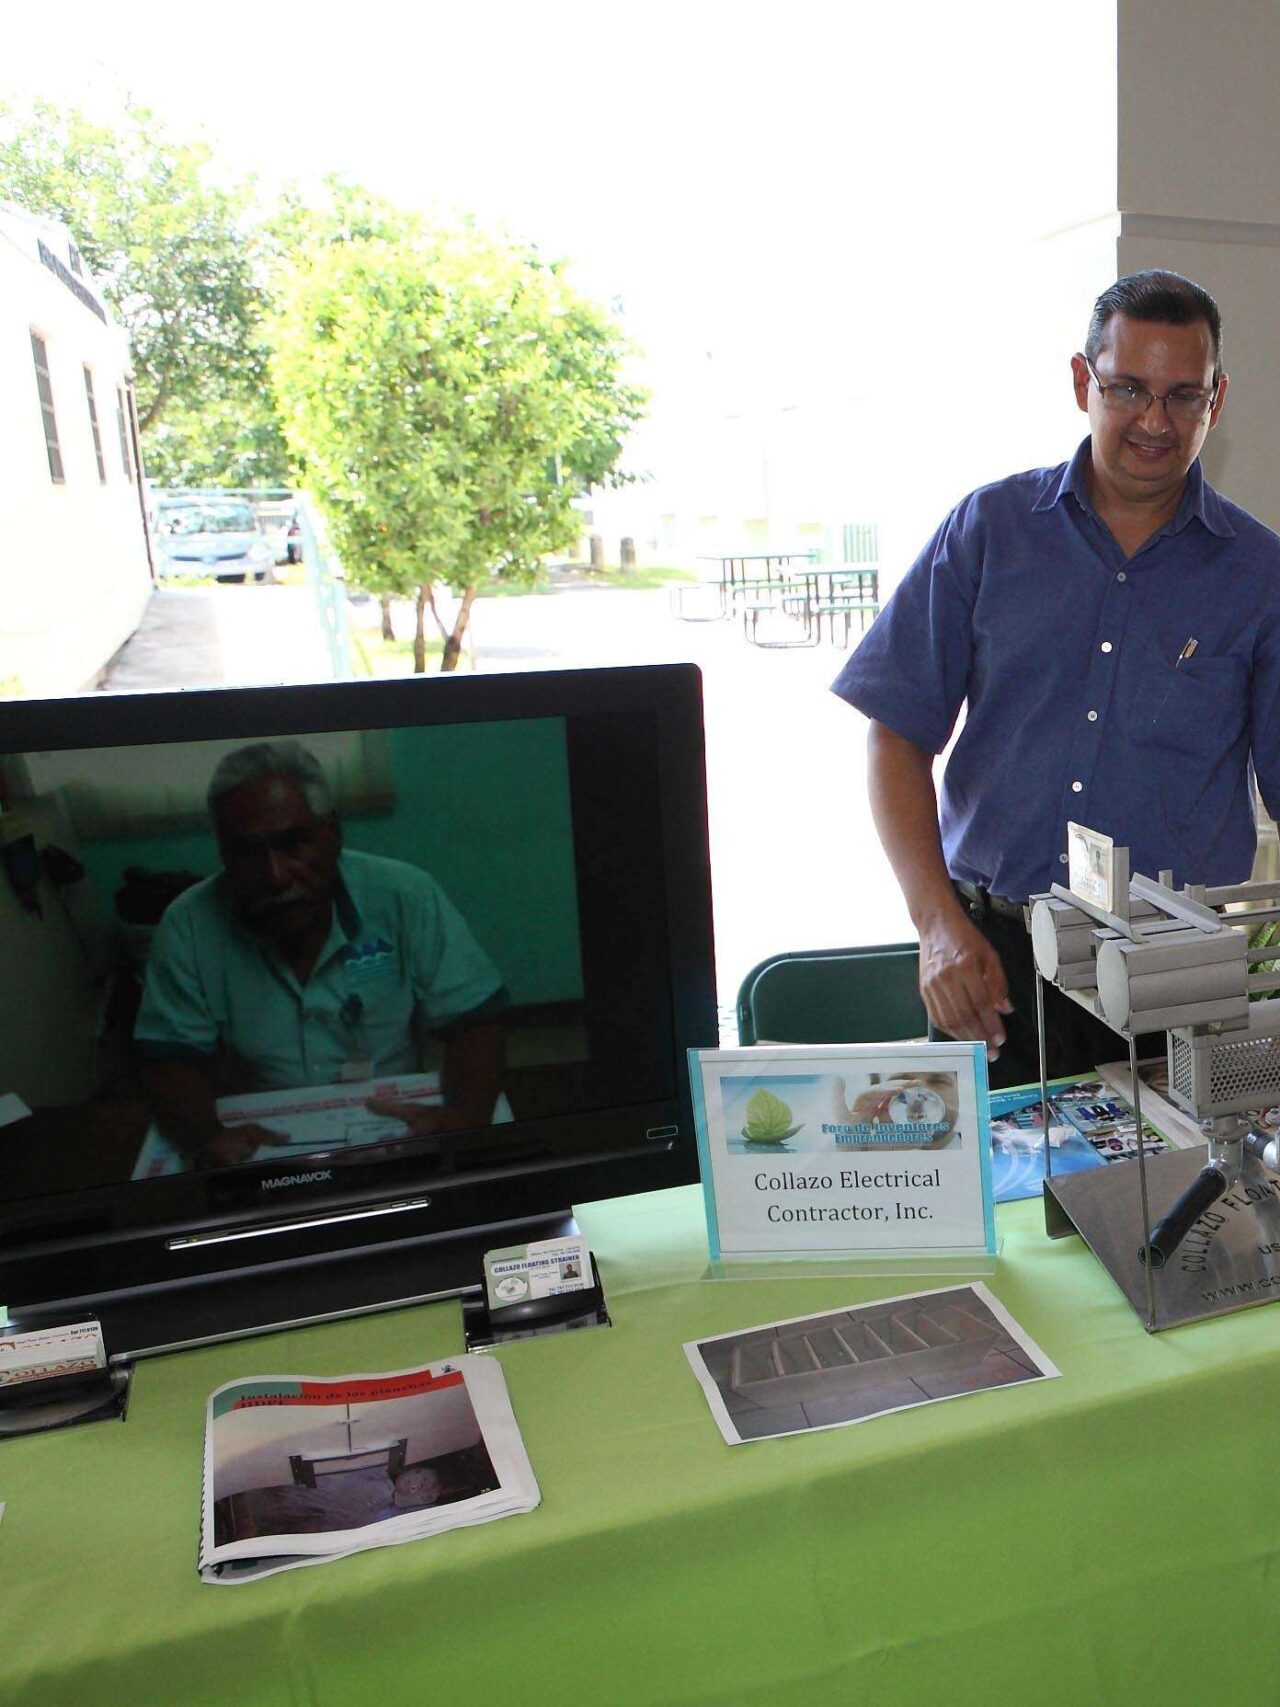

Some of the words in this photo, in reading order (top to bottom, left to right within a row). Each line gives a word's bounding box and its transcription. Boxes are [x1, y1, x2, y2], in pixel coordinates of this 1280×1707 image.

[821, 1123, 849, 1134] Foro
[855, 1123, 870, 1133] de
[874, 1121, 950, 1135] Inventores
[834, 1132, 933, 1144] Emprendedores
[261, 1170, 332, 1190] MAGNAVOX
[755, 1172, 832, 1191] Collazo
[840, 1169, 940, 1188] Electrical
[767, 1204, 888, 1223] Contractor,
[896, 1202, 933, 1220] Inc.
[1181, 1211, 1226, 1273] COLLAZO
[494, 1263, 520, 1274] COLLAZO
[521, 1259, 550, 1269] FLOATING
[550, 1254, 580, 1264] STRAINER
